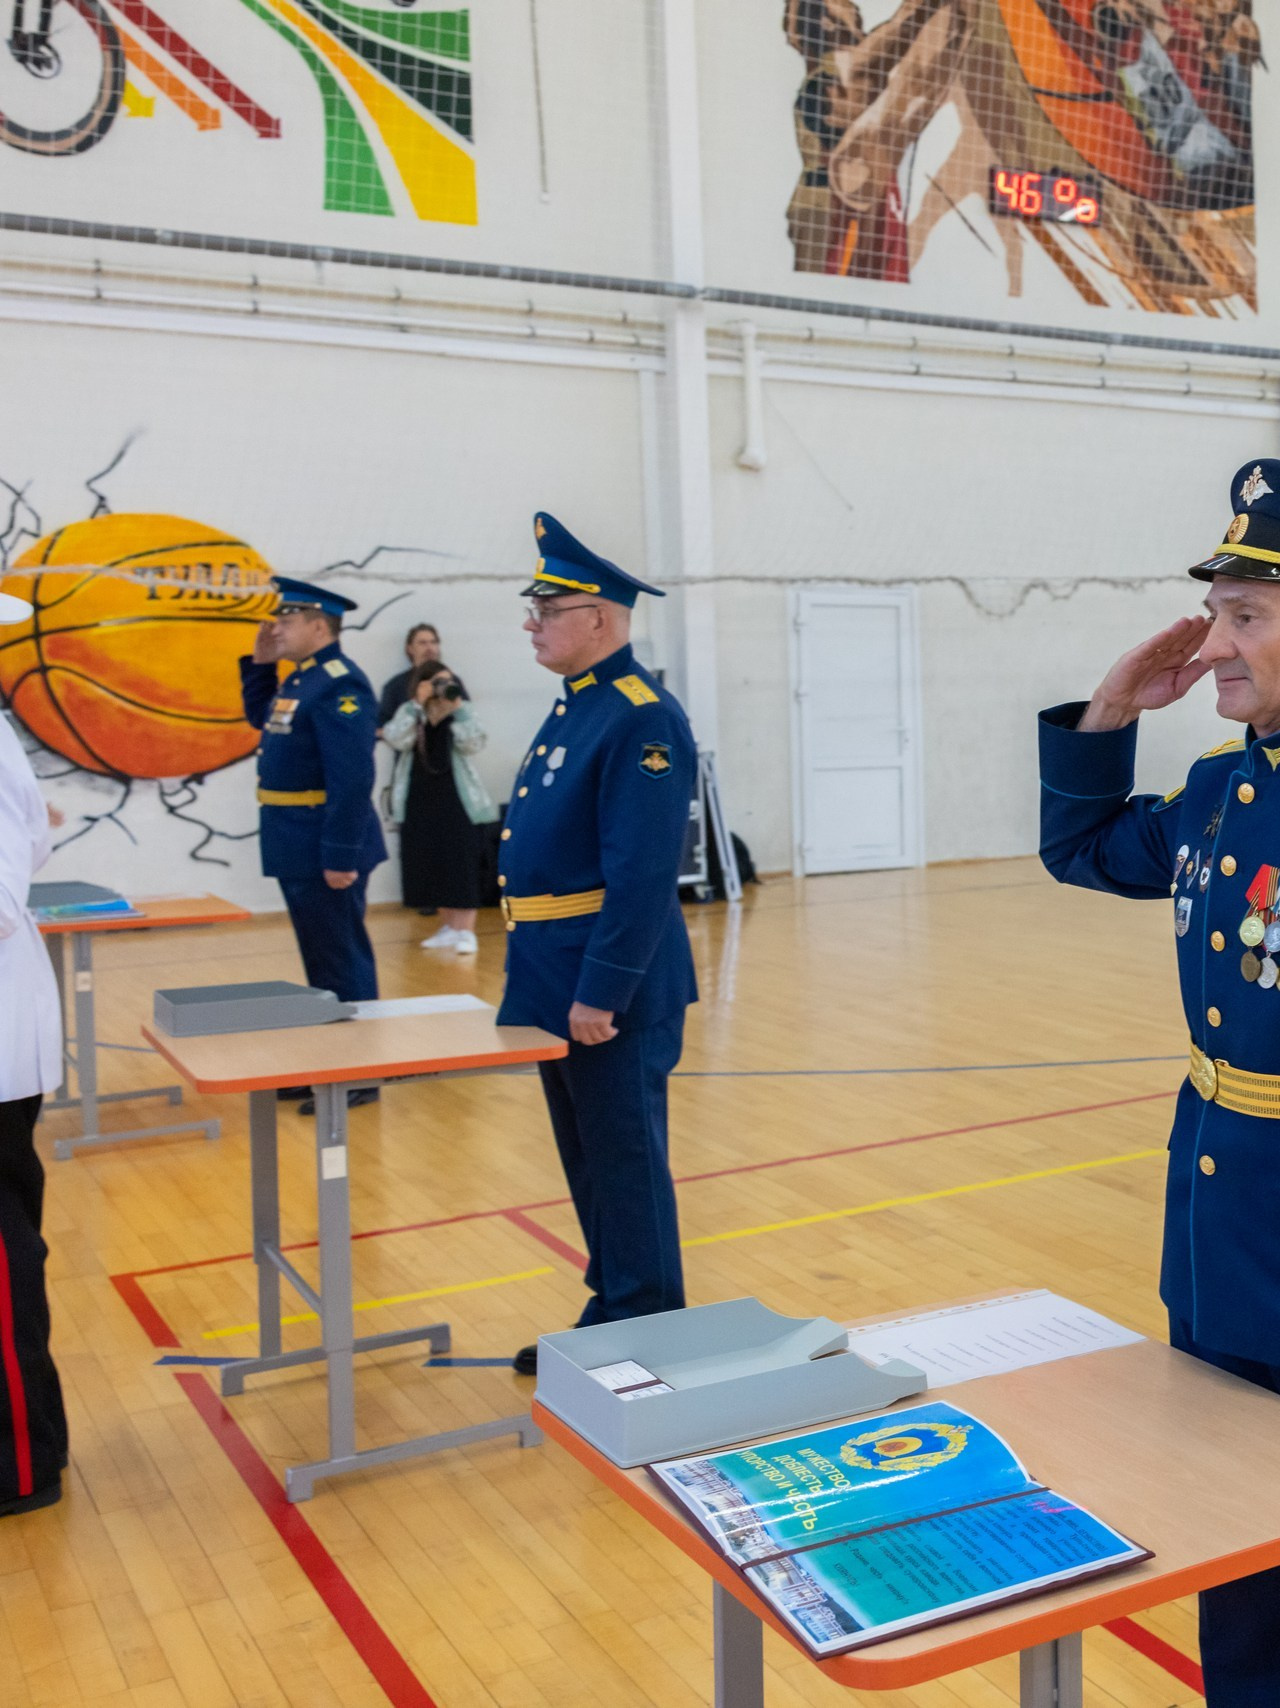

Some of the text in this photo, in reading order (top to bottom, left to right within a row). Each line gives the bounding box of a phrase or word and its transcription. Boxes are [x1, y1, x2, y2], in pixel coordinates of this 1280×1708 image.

[995, 170, 1042, 216] 46
[736, 1450, 785, 1485] УПОРСТВО
[772, 1454, 824, 1493] ДОБЛЕСТЬ
[797, 1448, 851, 1490] МУЖЕСТВО
